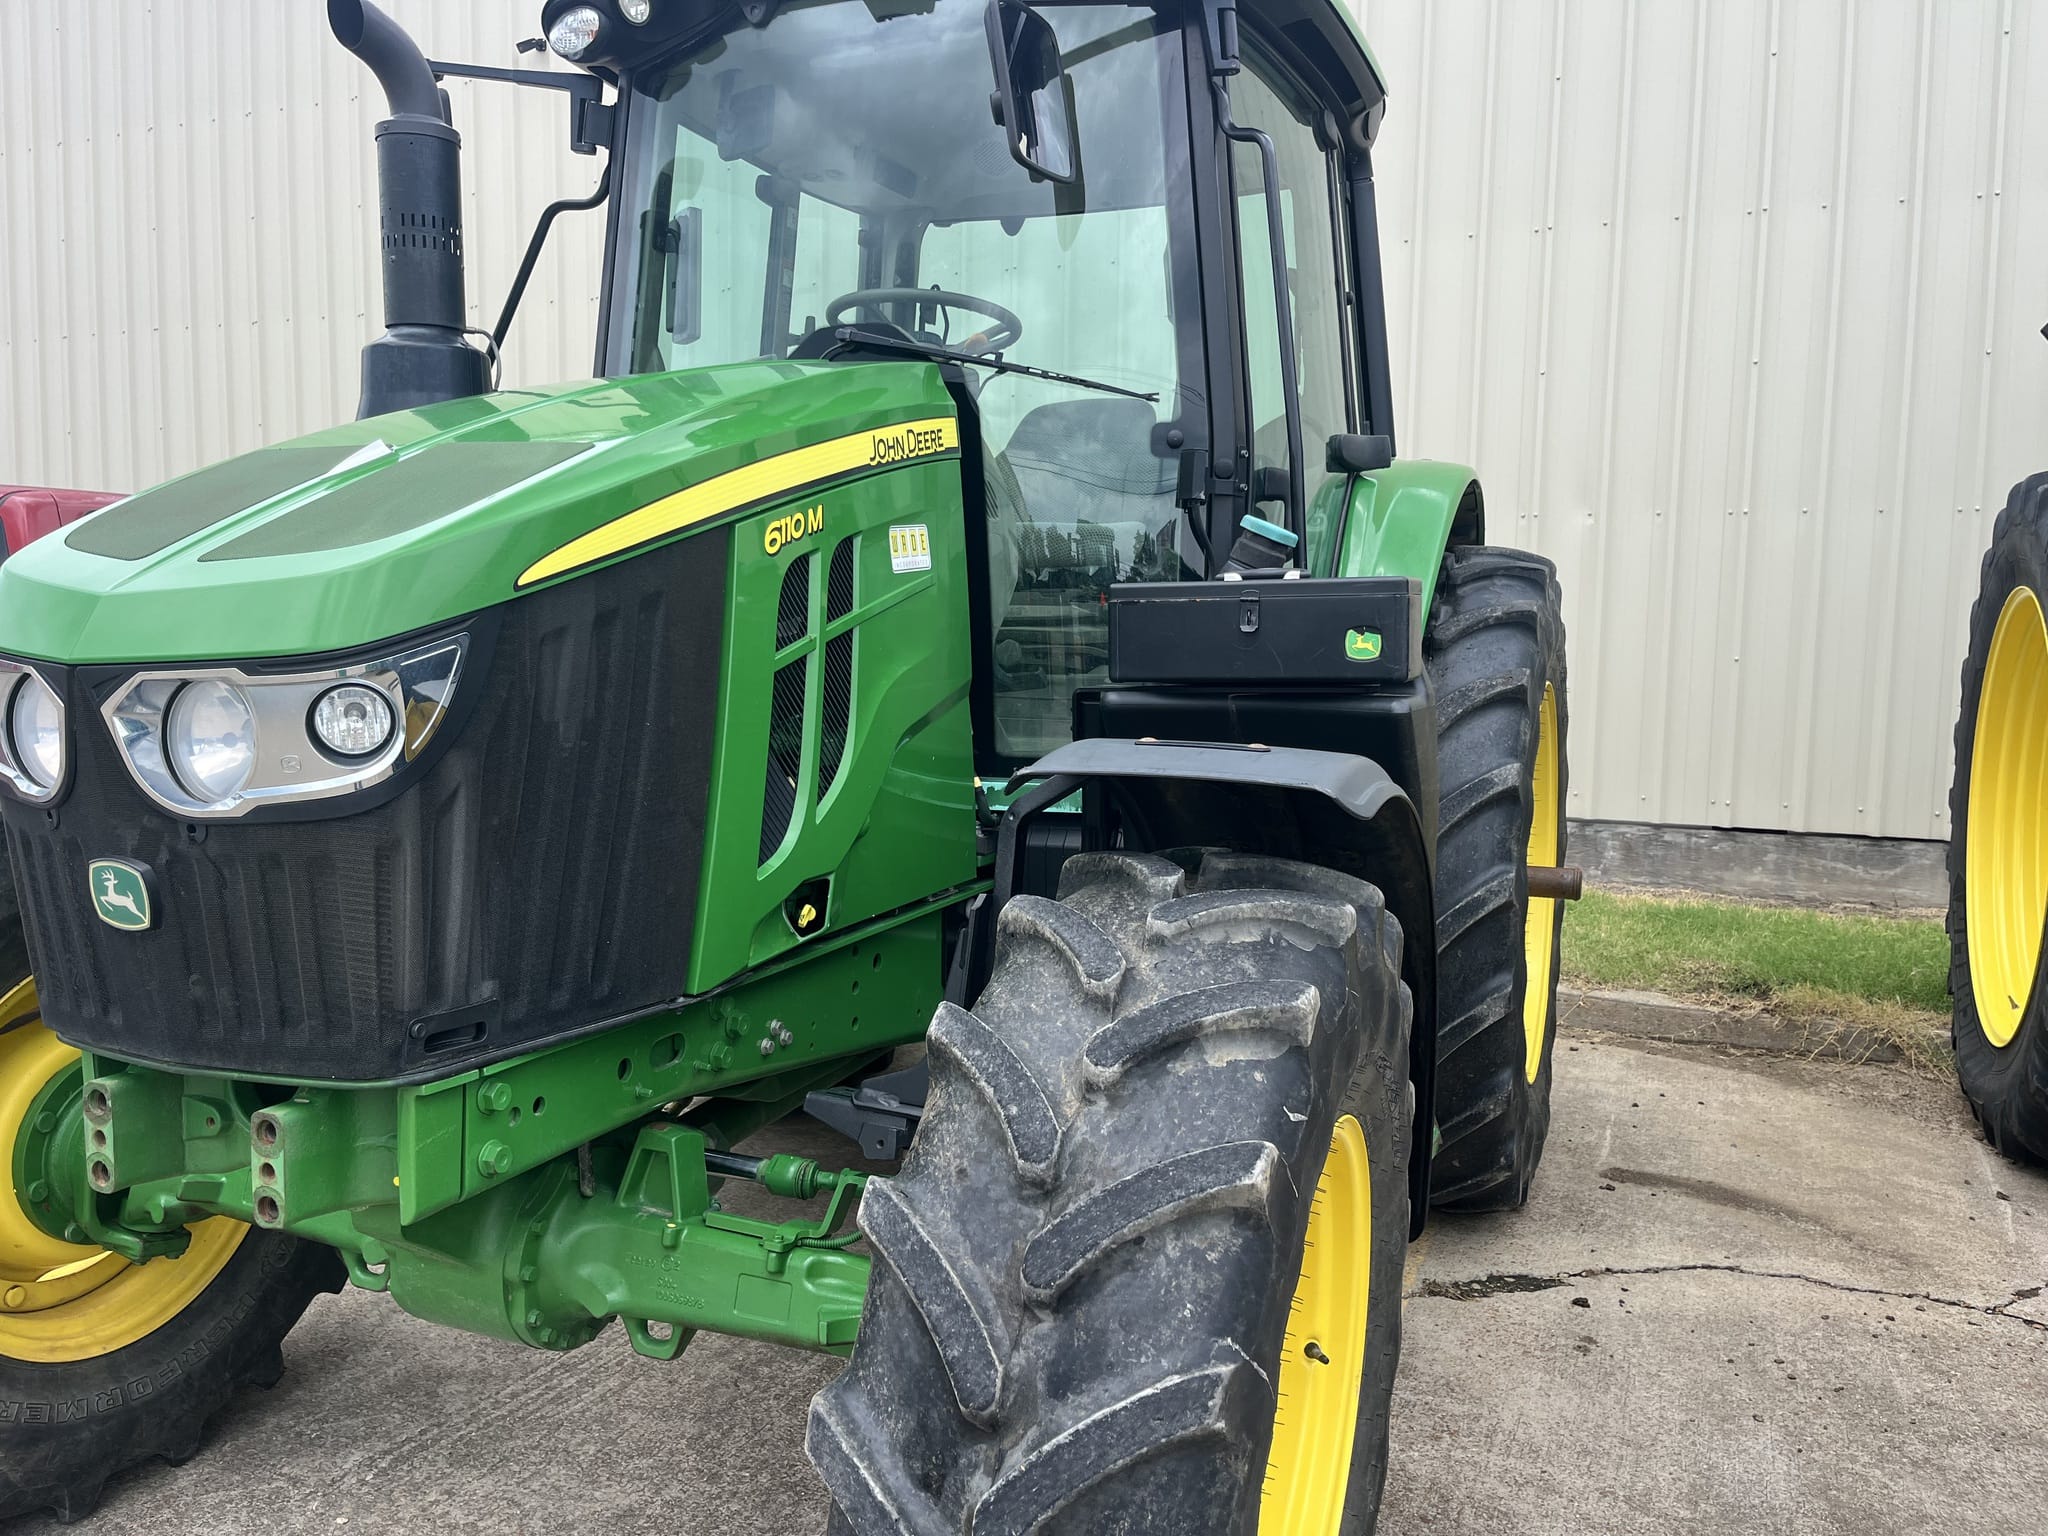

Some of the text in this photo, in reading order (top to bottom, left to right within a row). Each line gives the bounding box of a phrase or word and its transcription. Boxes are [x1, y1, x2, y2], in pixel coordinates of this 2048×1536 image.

[870, 429, 944, 462] JOHN DEERE
[764, 504, 823, 556] 6110 M
[0, 1292, 256, 1424] PERFORMER
